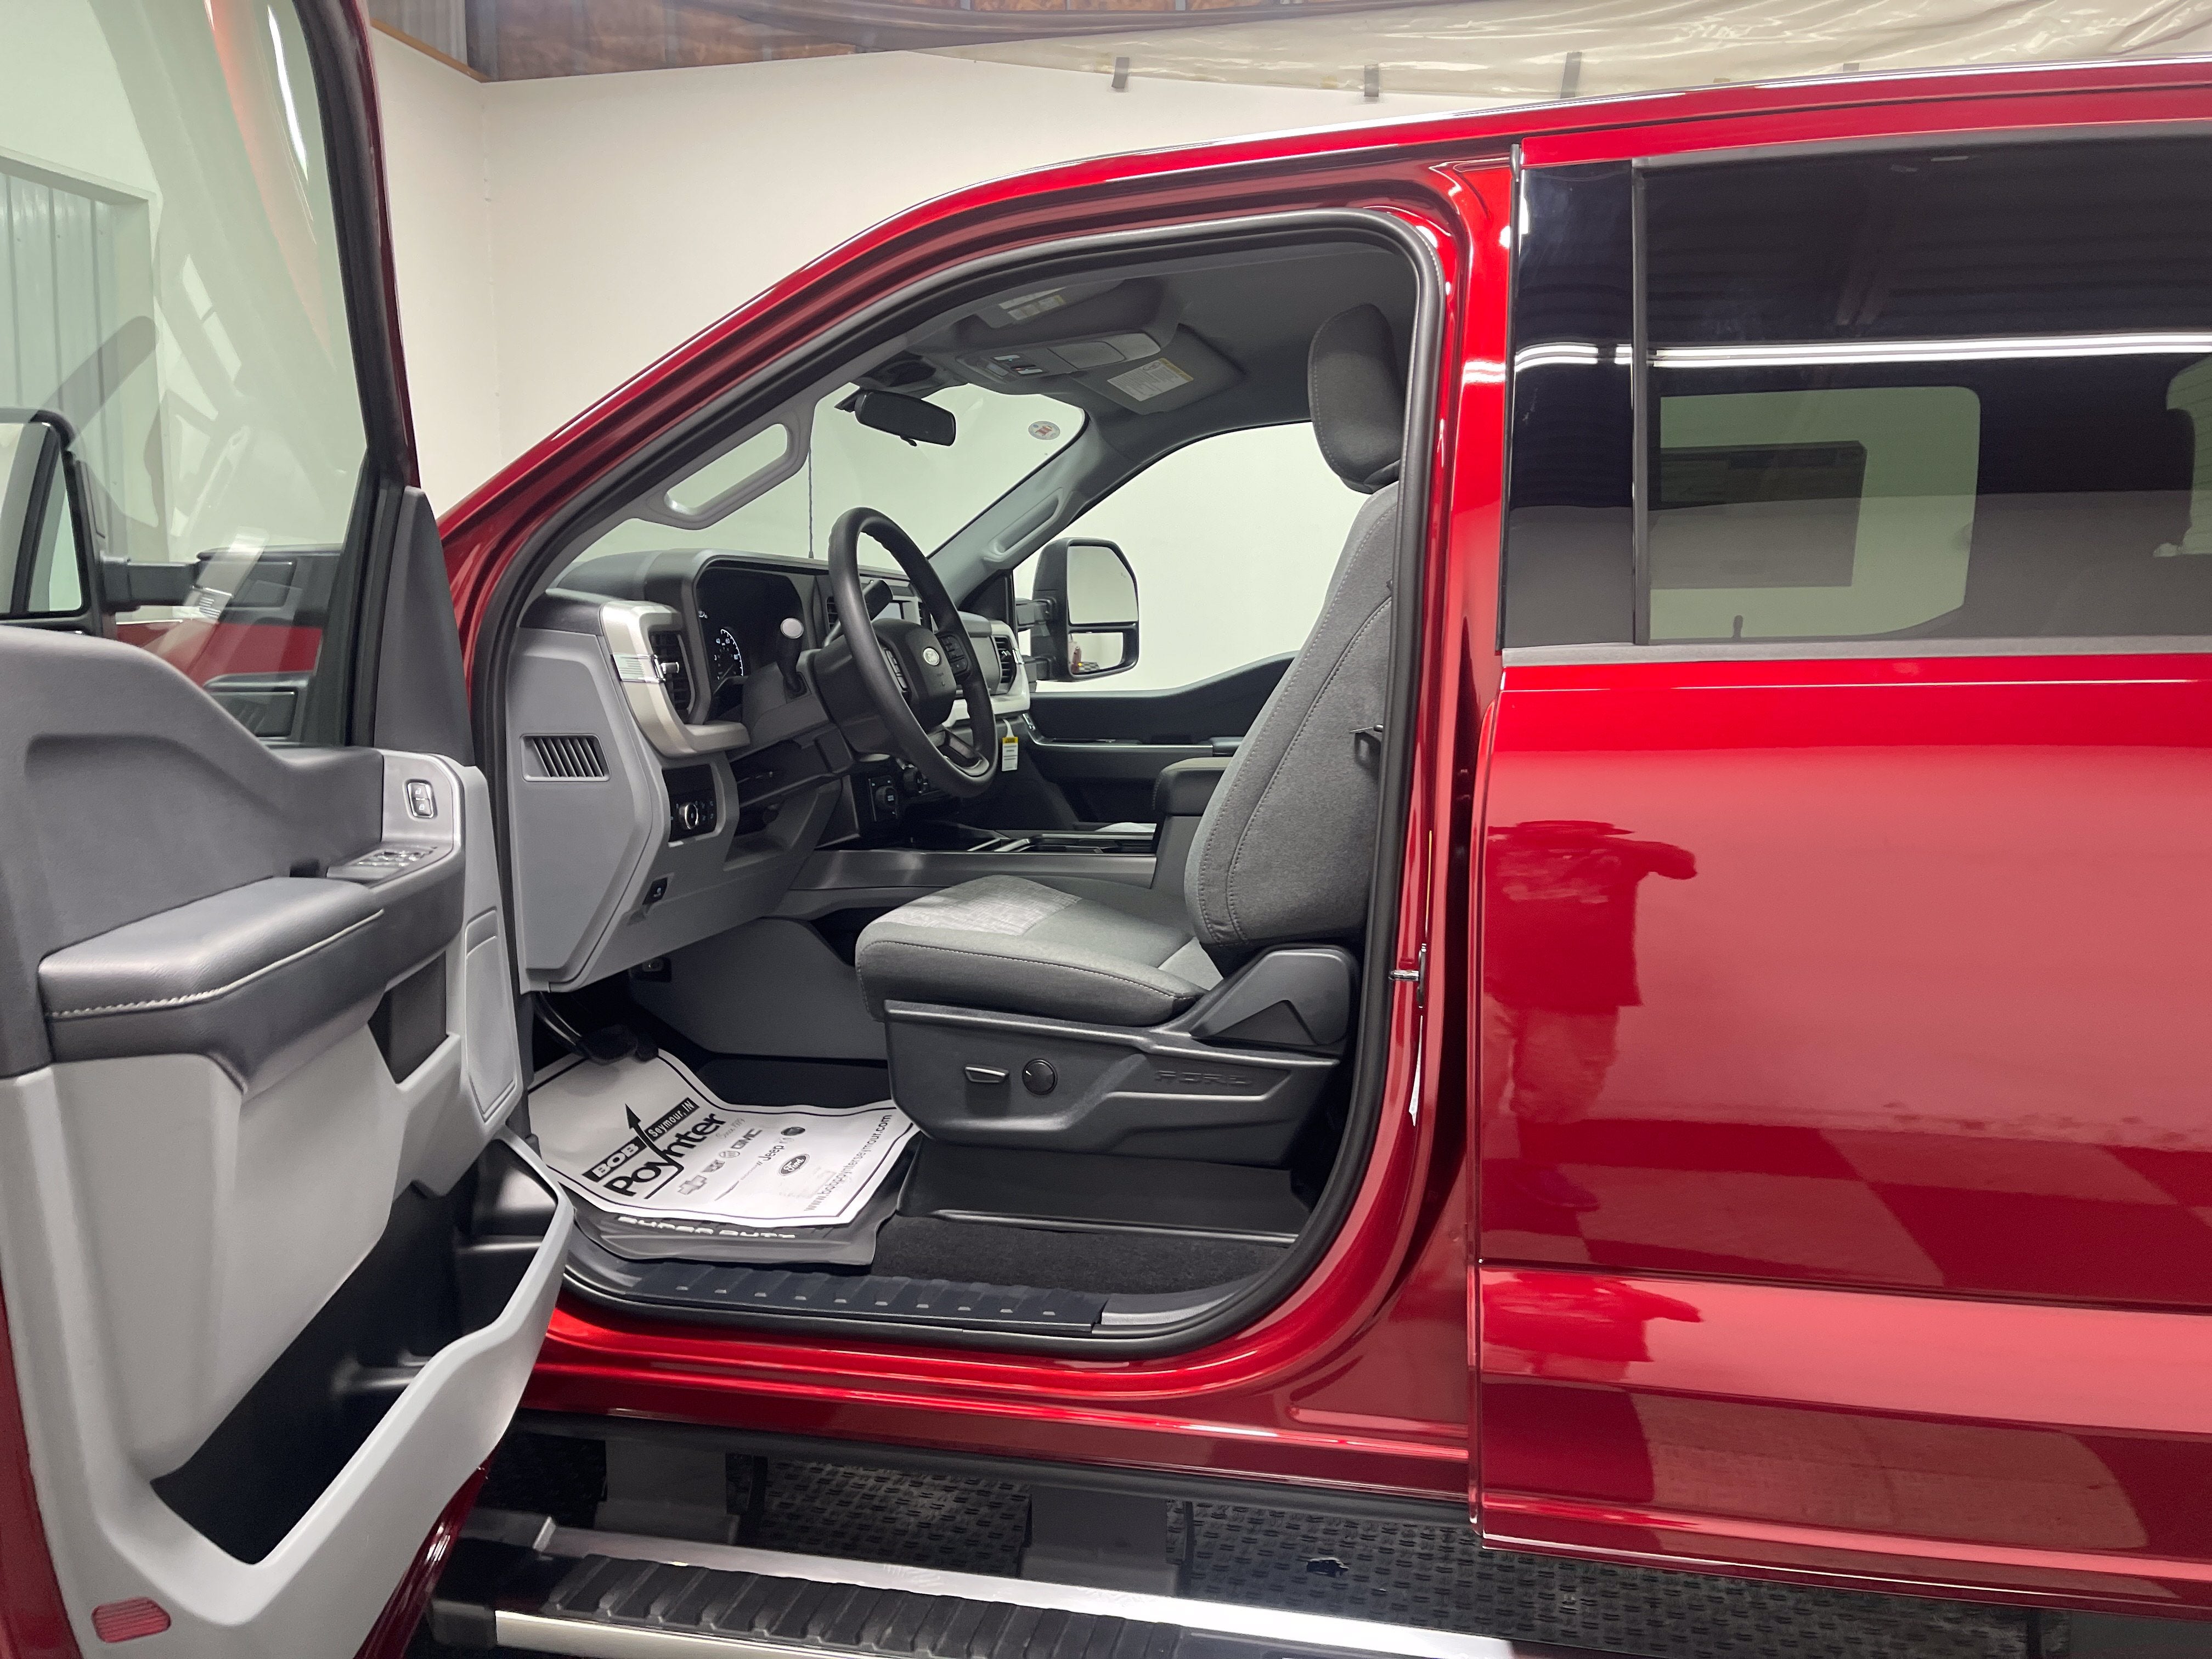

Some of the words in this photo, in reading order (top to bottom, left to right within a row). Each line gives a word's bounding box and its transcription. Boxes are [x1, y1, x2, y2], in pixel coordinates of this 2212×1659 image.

[1154, 1070, 1253, 1085] FORD
[684, 1099, 695, 1114] IN
[730, 1127, 763, 1149] GMC
[591, 1143, 640, 1178] BOB
[602, 1113, 726, 1197] Poynter
[758, 1145, 785, 1161] Jeep
